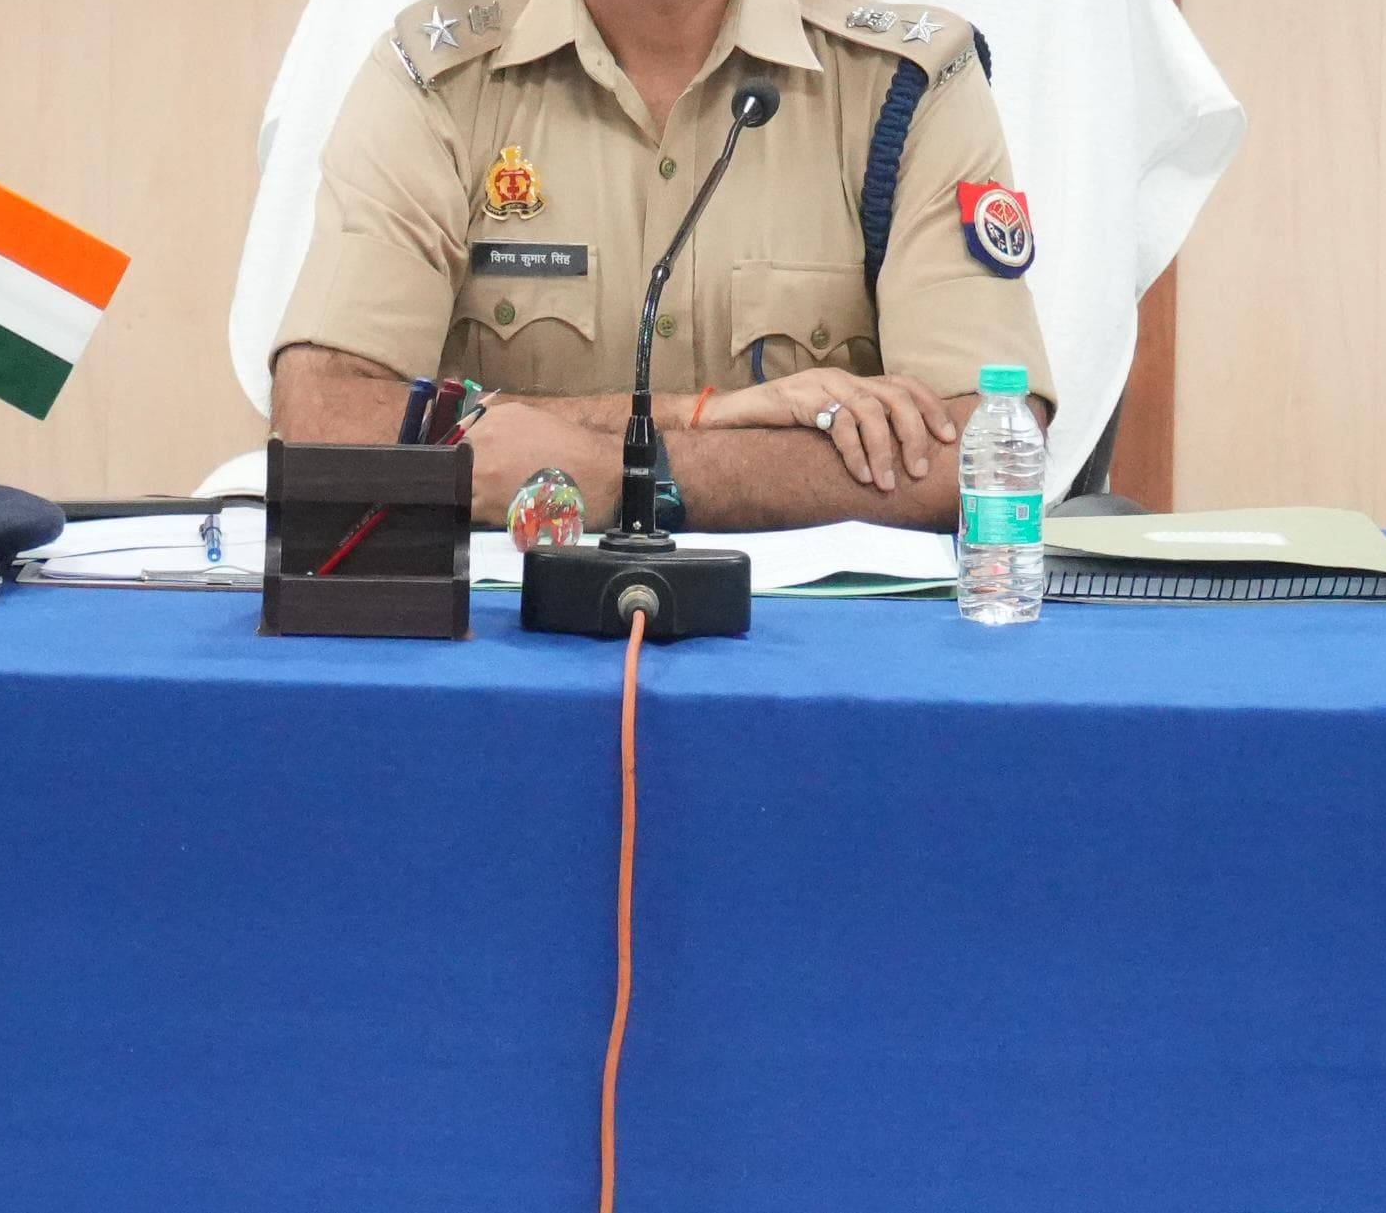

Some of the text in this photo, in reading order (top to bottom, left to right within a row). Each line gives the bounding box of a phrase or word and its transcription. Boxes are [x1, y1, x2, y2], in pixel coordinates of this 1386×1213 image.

[490, 250, 571, 267] विनय कुमार सिंह
